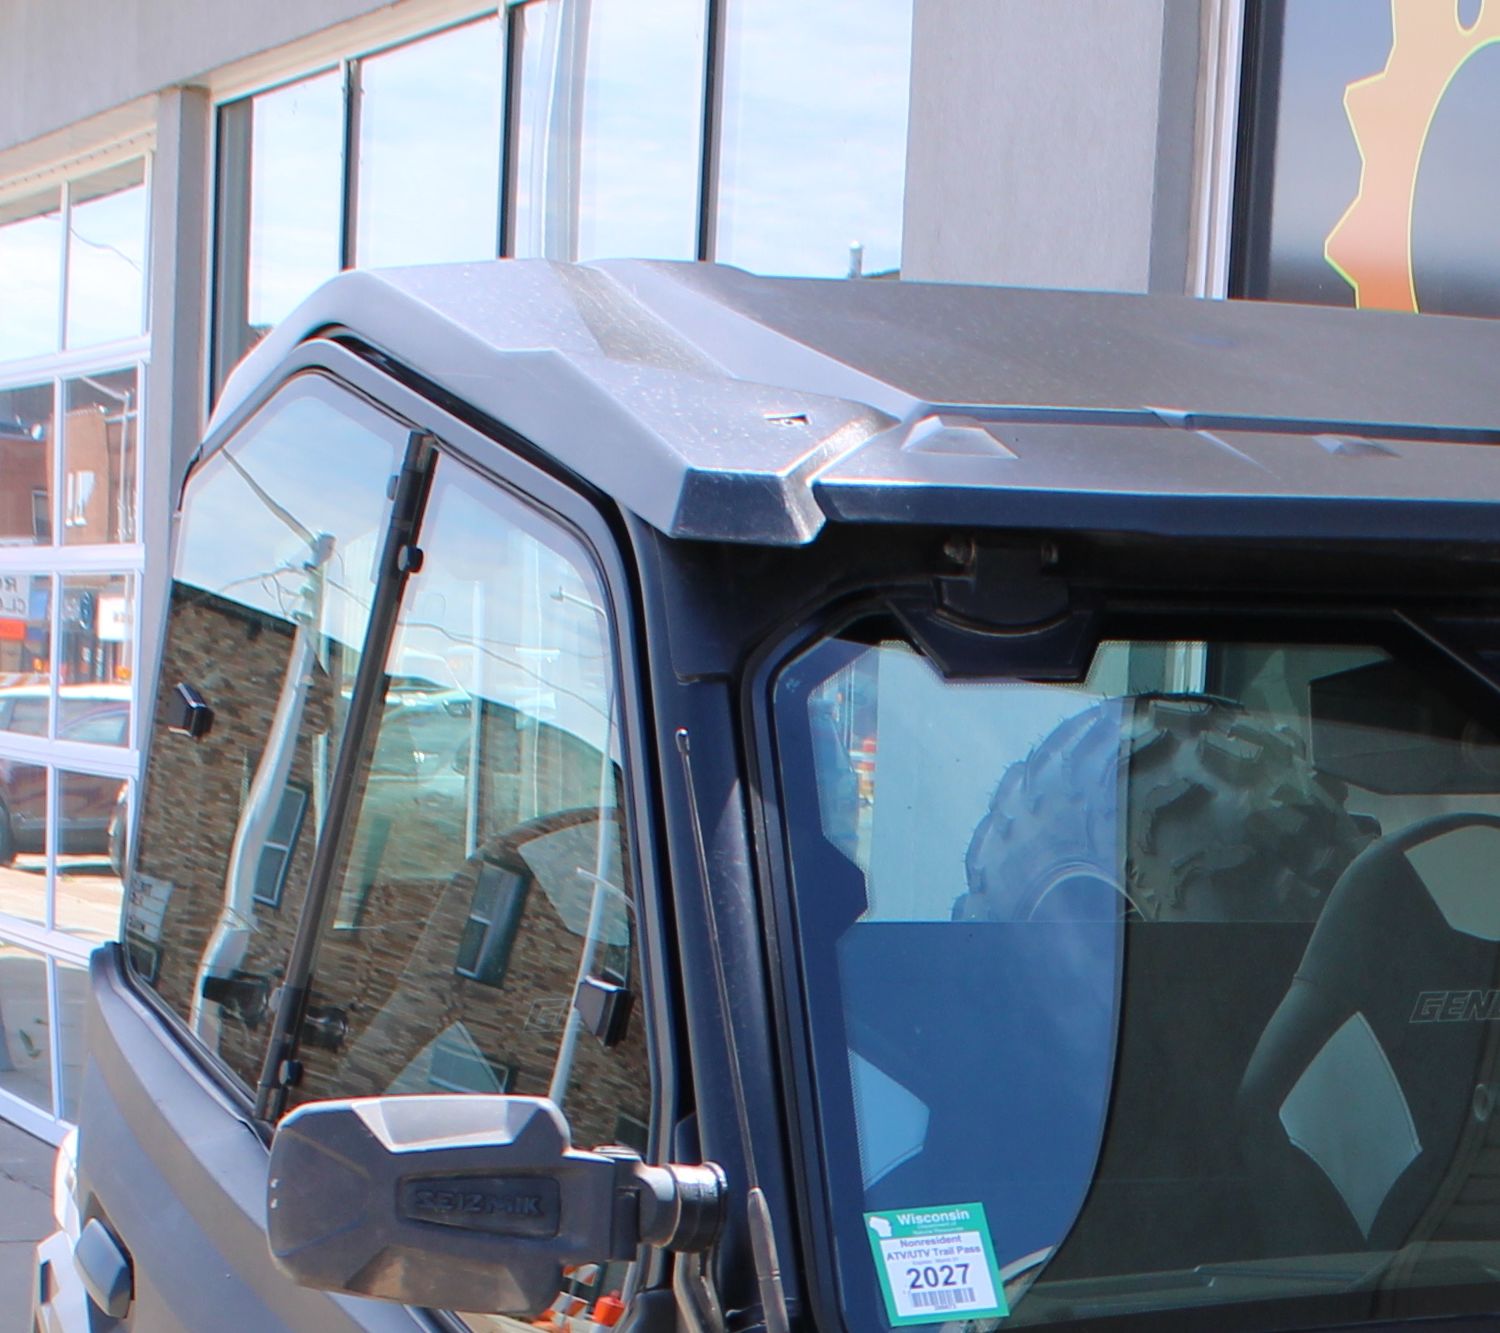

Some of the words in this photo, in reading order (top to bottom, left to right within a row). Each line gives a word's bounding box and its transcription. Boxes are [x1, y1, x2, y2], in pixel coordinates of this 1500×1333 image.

[415, 1190, 544, 1215] SEIZMIK
[897, 1209, 970, 1225] Wisconsin
[901, 1235, 961, 1247] Nonresident
[886, 1249, 931, 1261] ATV/UTV
[933, 1247, 955, 1257] Trail
[957, 1245, 981, 1254] Pass
[907, 1264, 970, 1289] 2027
